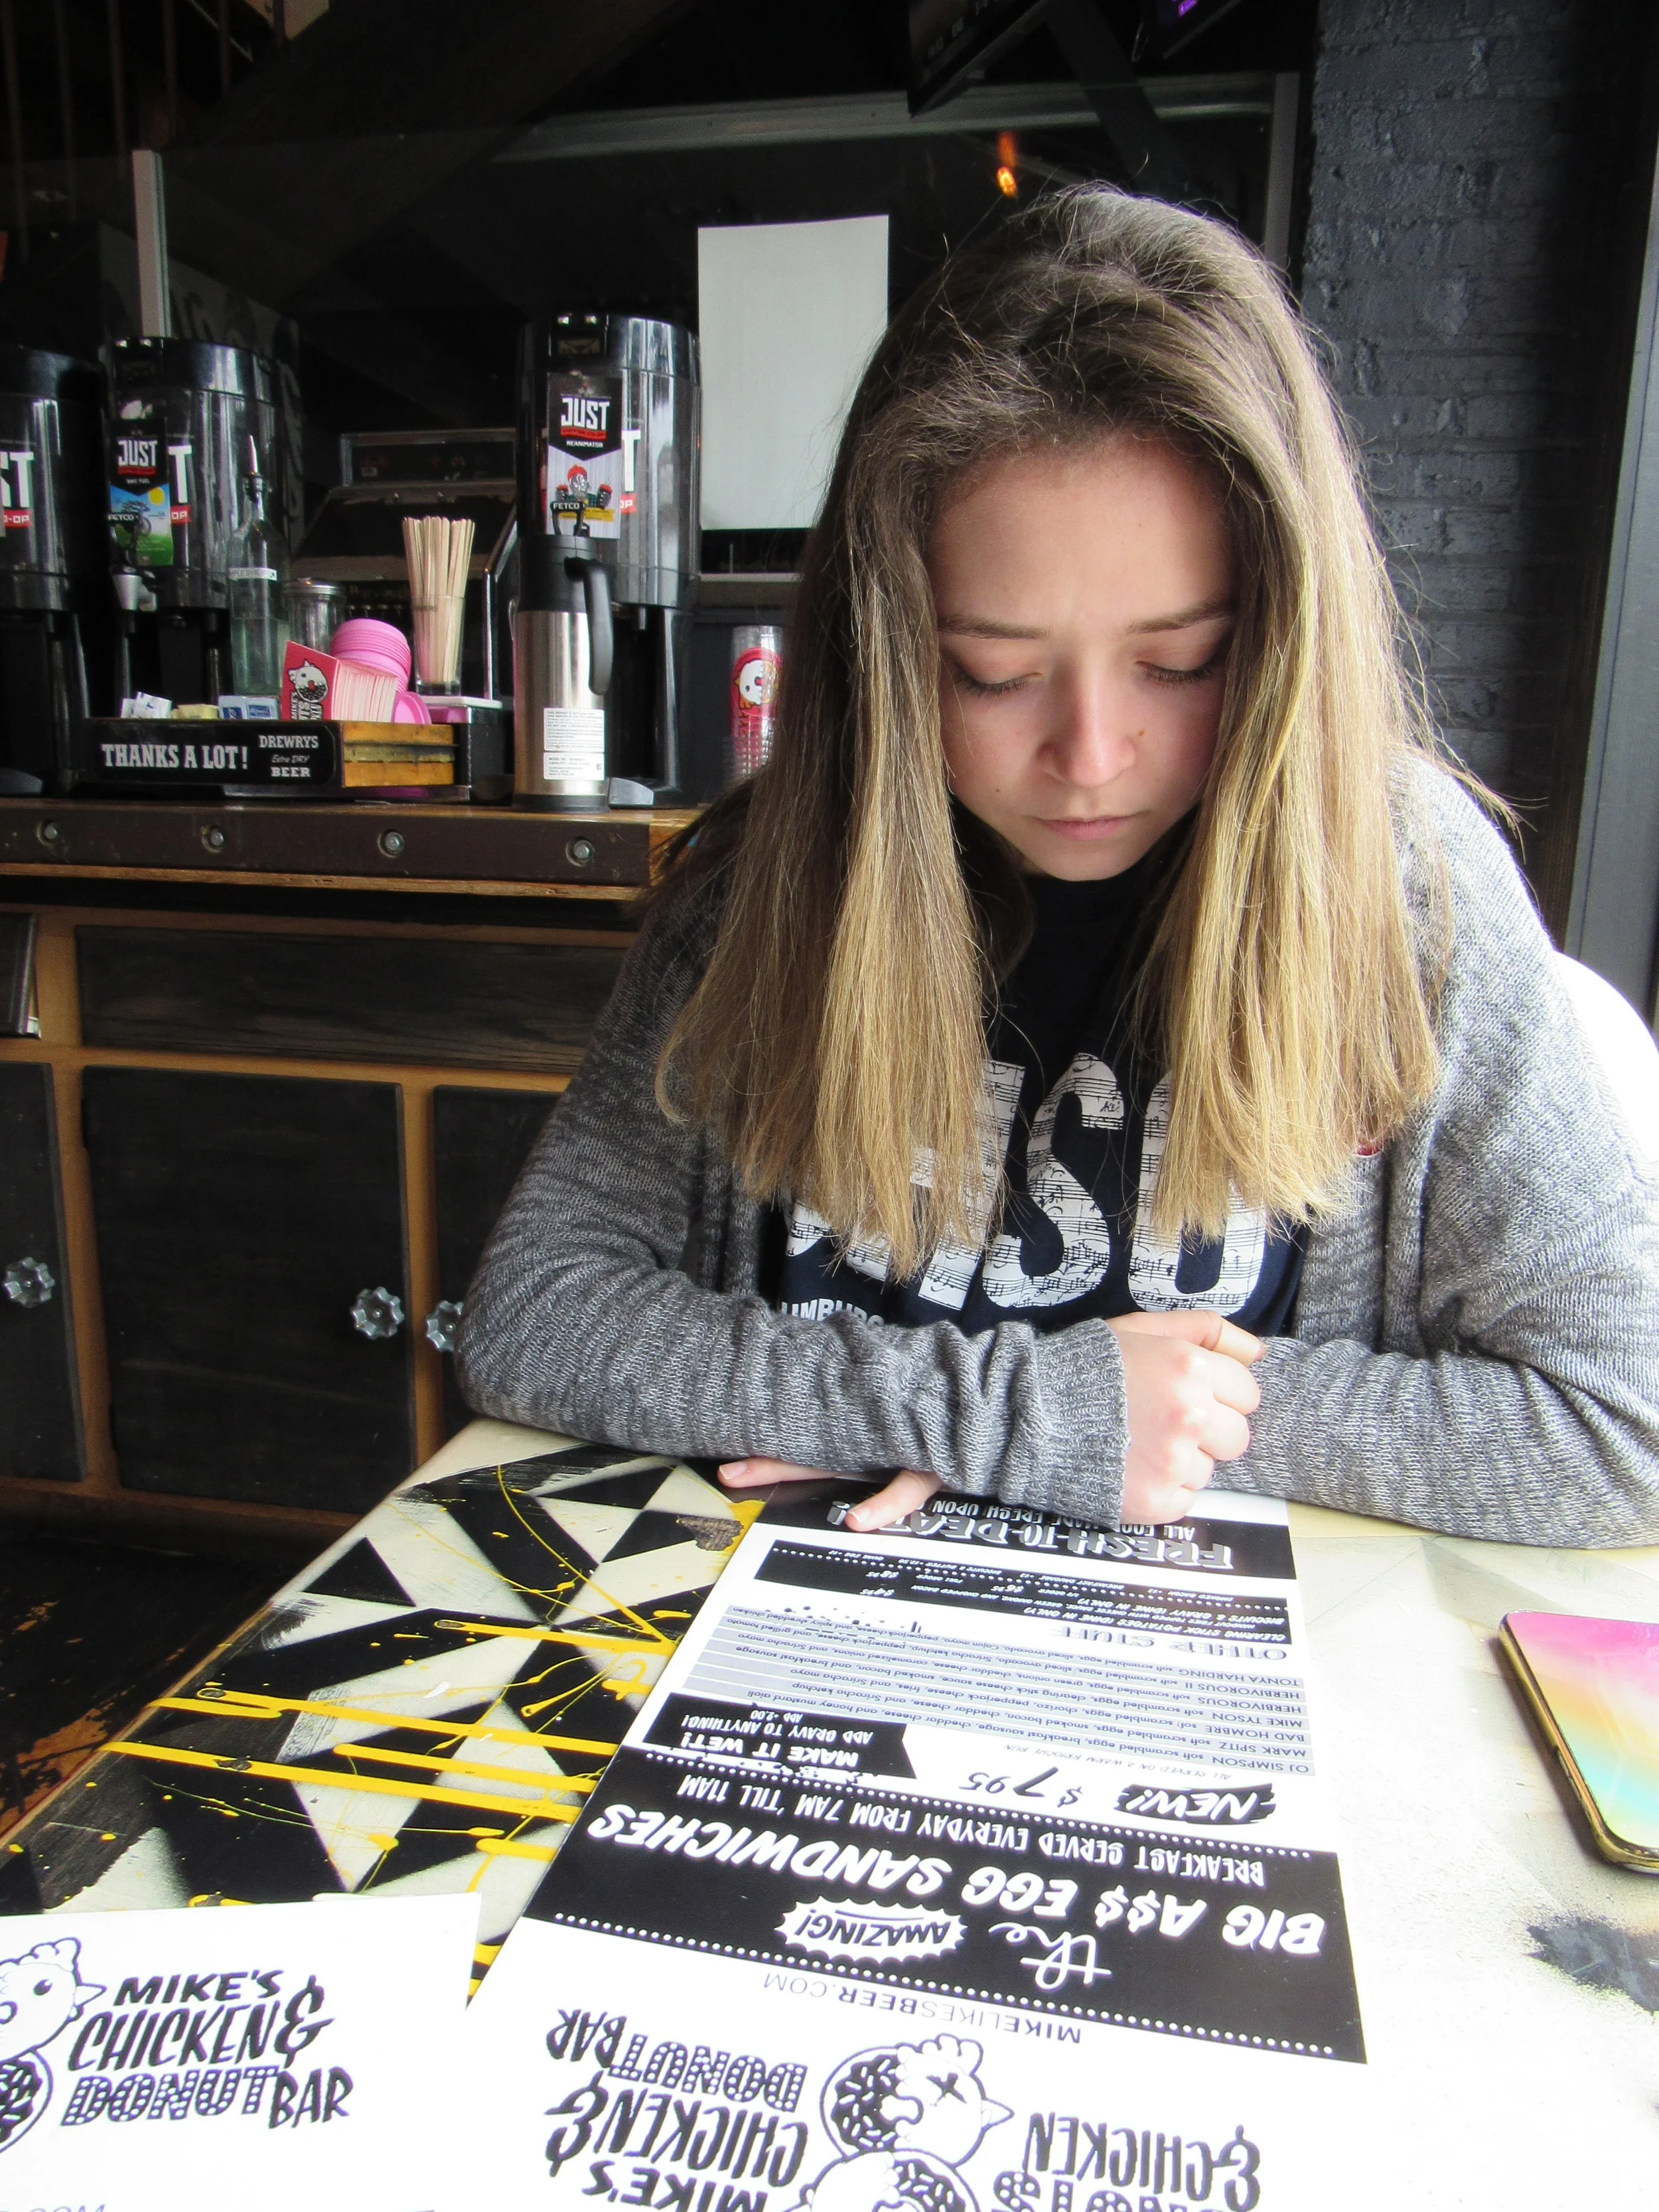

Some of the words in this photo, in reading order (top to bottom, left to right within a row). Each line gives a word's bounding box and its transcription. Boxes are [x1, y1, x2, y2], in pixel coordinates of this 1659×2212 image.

[561, 398, 611, 430] JUST
[118, 439, 158, 467] JUST
[553, 501, 580, 510] FETCO
[258, 735, 319, 749] DREWRYS
[102, 743, 179, 768] THANKS
[184, 745, 198, 769] A
[202, 745, 248, 771] LOT!
[271, 767, 311, 777] BEER
[929, 1500, 981, 1518] UPON
[984, 1505, 1044, 1525] FRESH
[1164, 1524, 1196, 1542] ALL
[731, 1607, 766, 1618] chicken
[766, 1613, 808, 1625] shredded
[1169, 1610, 1212, 1619] GRAVY
[725, 1619, 760, 1629] tomato
[810, 1619, 833, 1629] spicy
[1117, 1619, 1182, 1633] POTATOES
[1228, 1615, 1285, 1625] BISCUITS
[760, 1623, 792, 1635] grilled
[792, 1630, 812, 1639] and
[1183, 1627, 1222, 1637] STICK
[737, 1632, 766, 1643] mayo
[1224, 1631, 1286, 1642] CLEARING
[766, 1639, 807, 1651] Sriracha
[808, 1645, 829, 1654] and
[851, 1637, 906, 1652] pepperjack
[735, 1645, 779, 1659] sausage
[830, 1647, 867, 1659] onions,
[951, 1652, 993, 1663] Sriracha
[1048, 1652, 1074, 1661] sliced
[779, 1654, 830, 1668] breakfast
[831, 1662, 852, 1671] and
[867, 1654, 928, 1668] caramelized
[930, 1660, 968, 1673] cheese,
[1106, 1660, 1153, 1672] scrambled
[790, 1667, 821, 1678] mayo
[854, 1663, 893, 1676] bacon,
[894, 1670, 935, 1682] smoked
[970, 1667, 1012, 1680] cheddar
[1045, 1664, 1072, 1674] sliced
[1179, 1668, 1244, 1682] HARDING
[822, 1674, 868, 1686] Sriracha
[870, 1680, 892, 1690] and
[939, 1675, 973, 1686] sauce,
[1015, 1672, 1051, 1685] onions,
[1054, 1677, 1083, 1688] green
[1106, 1672, 1157, 1686] scrambled
[1161, 1679, 1178, 1688] soft
[1248, 1676, 1299, 1687] TONYA
[790, 1681, 834, 1696] ketchup
[895, 1682, 921, 1694] fries,
[923, 1686, 965, 1700] cheese,
[975, 1682, 1013, 1694] cheese
[1016, 1687, 1039, 1697] stick
[1117, 1687, 1169, 1700] scrambled
[1198, 1683, 1300, 1700] HERBIVOROUS
[747, 1690, 772, 1701] aioli
[773, 1694, 818, 1708] mustard
[835, 1690, 882, 1703] Sriracha
[885, 1696, 907, 1706] and
[967, 1692, 1030, 1709] pepperjack
[1042, 1689, 1086, 1704] clearing
[1090, 1696, 1119, 1706] eggs,
[1173, 1694, 1190, 1703] soft
[819, 1700, 855, 1714] honey
[855, 1706, 878, 1717] and
[909, 1698, 952, 1712] cheese,
[1033, 1701, 1078, 1716] chorizo,
[1123, 1702, 1180, 1716] scrambled
[1198, 1697, 1302, 1714] HERBIVOROUS
[784, 1713, 804, 1724] ADD
[880, 1708, 923, 1723] cheese,
[954, 1706, 1000, 1720] cheddar
[1004, 1711, 1043, 1726] bacon,
[1082, 1708, 1112, 1719] eggs,
[1185, 1709, 1204, 1719] soft
[1212, 1712, 1262, 1725] TYSON
[682, 1715, 762, 1734] ANYTHING!
[924, 1716, 972, 1730] cheddar
[1046, 1719, 1089, 1732] smoked
[1116, 1714, 1173, 1729] scrambled
[1266, 1718, 1303, 1729] MIKE
[764, 1723, 783, 1737] TO
[788, 1726, 837, 1743] GRAVY
[975, 1722, 1025, 1736] sausage,
[1094, 1724, 1123, 1735] eggs,
[1205, 1725, 1269, 1739] HOMBRE
[681, 1732, 743, 1754] WET!
[843, 1731, 874, 1745] ADD
[1027, 1731, 1081, 1746] breakfast
[1085, 1737, 1116, 1749] eggs,
[1128, 1730, 1187, 1745] scrambled
[1191, 1738, 1211, 1748] soft
[1275, 1732, 1305, 1743] BAD
[752, 1742, 781, 1759] IT
[1003, 1743, 1029, 1754] BUN
[1033, 1747, 1083, 1761] BRIOCHE
[1119, 1743, 1179, 1759] scrambled
[1219, 1741, 1256, 1753] SPITZ
[1262, 1746, 1307, 1759] MARK
[788, 1747, 859, 1767] MAKE
[1184, 1752, 1204, 1763] soft
[1212, 1756, 1284, 1771] SIMPSON
[1161, 1765, 1206, 1779] SERVED
[1289, 1764, 1309, 1774] OJ
[678, 1775, 729, 1802] 11AM
[740, 1785, 784, 1815] 'TILL
[1131, 1788, 1257, 1822] NEW!
[795, 1795, 843, 1821] 7AM
[850, 1803, 911, 1832] FROM
[918, 1814, 1029, 1851] EVERYDAY
[590, 1806, 949, 1894] SANDWICHES
[1039, 1833, 1123, 1865] SERVED
[1135, 1847, 1264, 1886] BREAKFAST
[962, 1867, 1078, 1917] EGG
[799, 1907, 951, 1952] AMAZING!
[1223, 1905, 1325, 1954] BIG
[990, 1923, 1111, 1990] the
[111, 1969, 285, 2007] MIKE'S
[762, 1972, 1083, 2045] MIKELIKESBEER.COM
[67, 2000, 281, 2071] CHICKEN
[274, 1974, 335, 2069] &
[545, 2009, 627, 2069] BAR
[607, 2033, 808, 2113] DONUT
[59, 2065, 281, 2127] DONUT
[267, 2065, 354, 2130] BAR
[543, 2069, 609, 2177] &
[593, 2088, 808, 2188] CHICKEN
